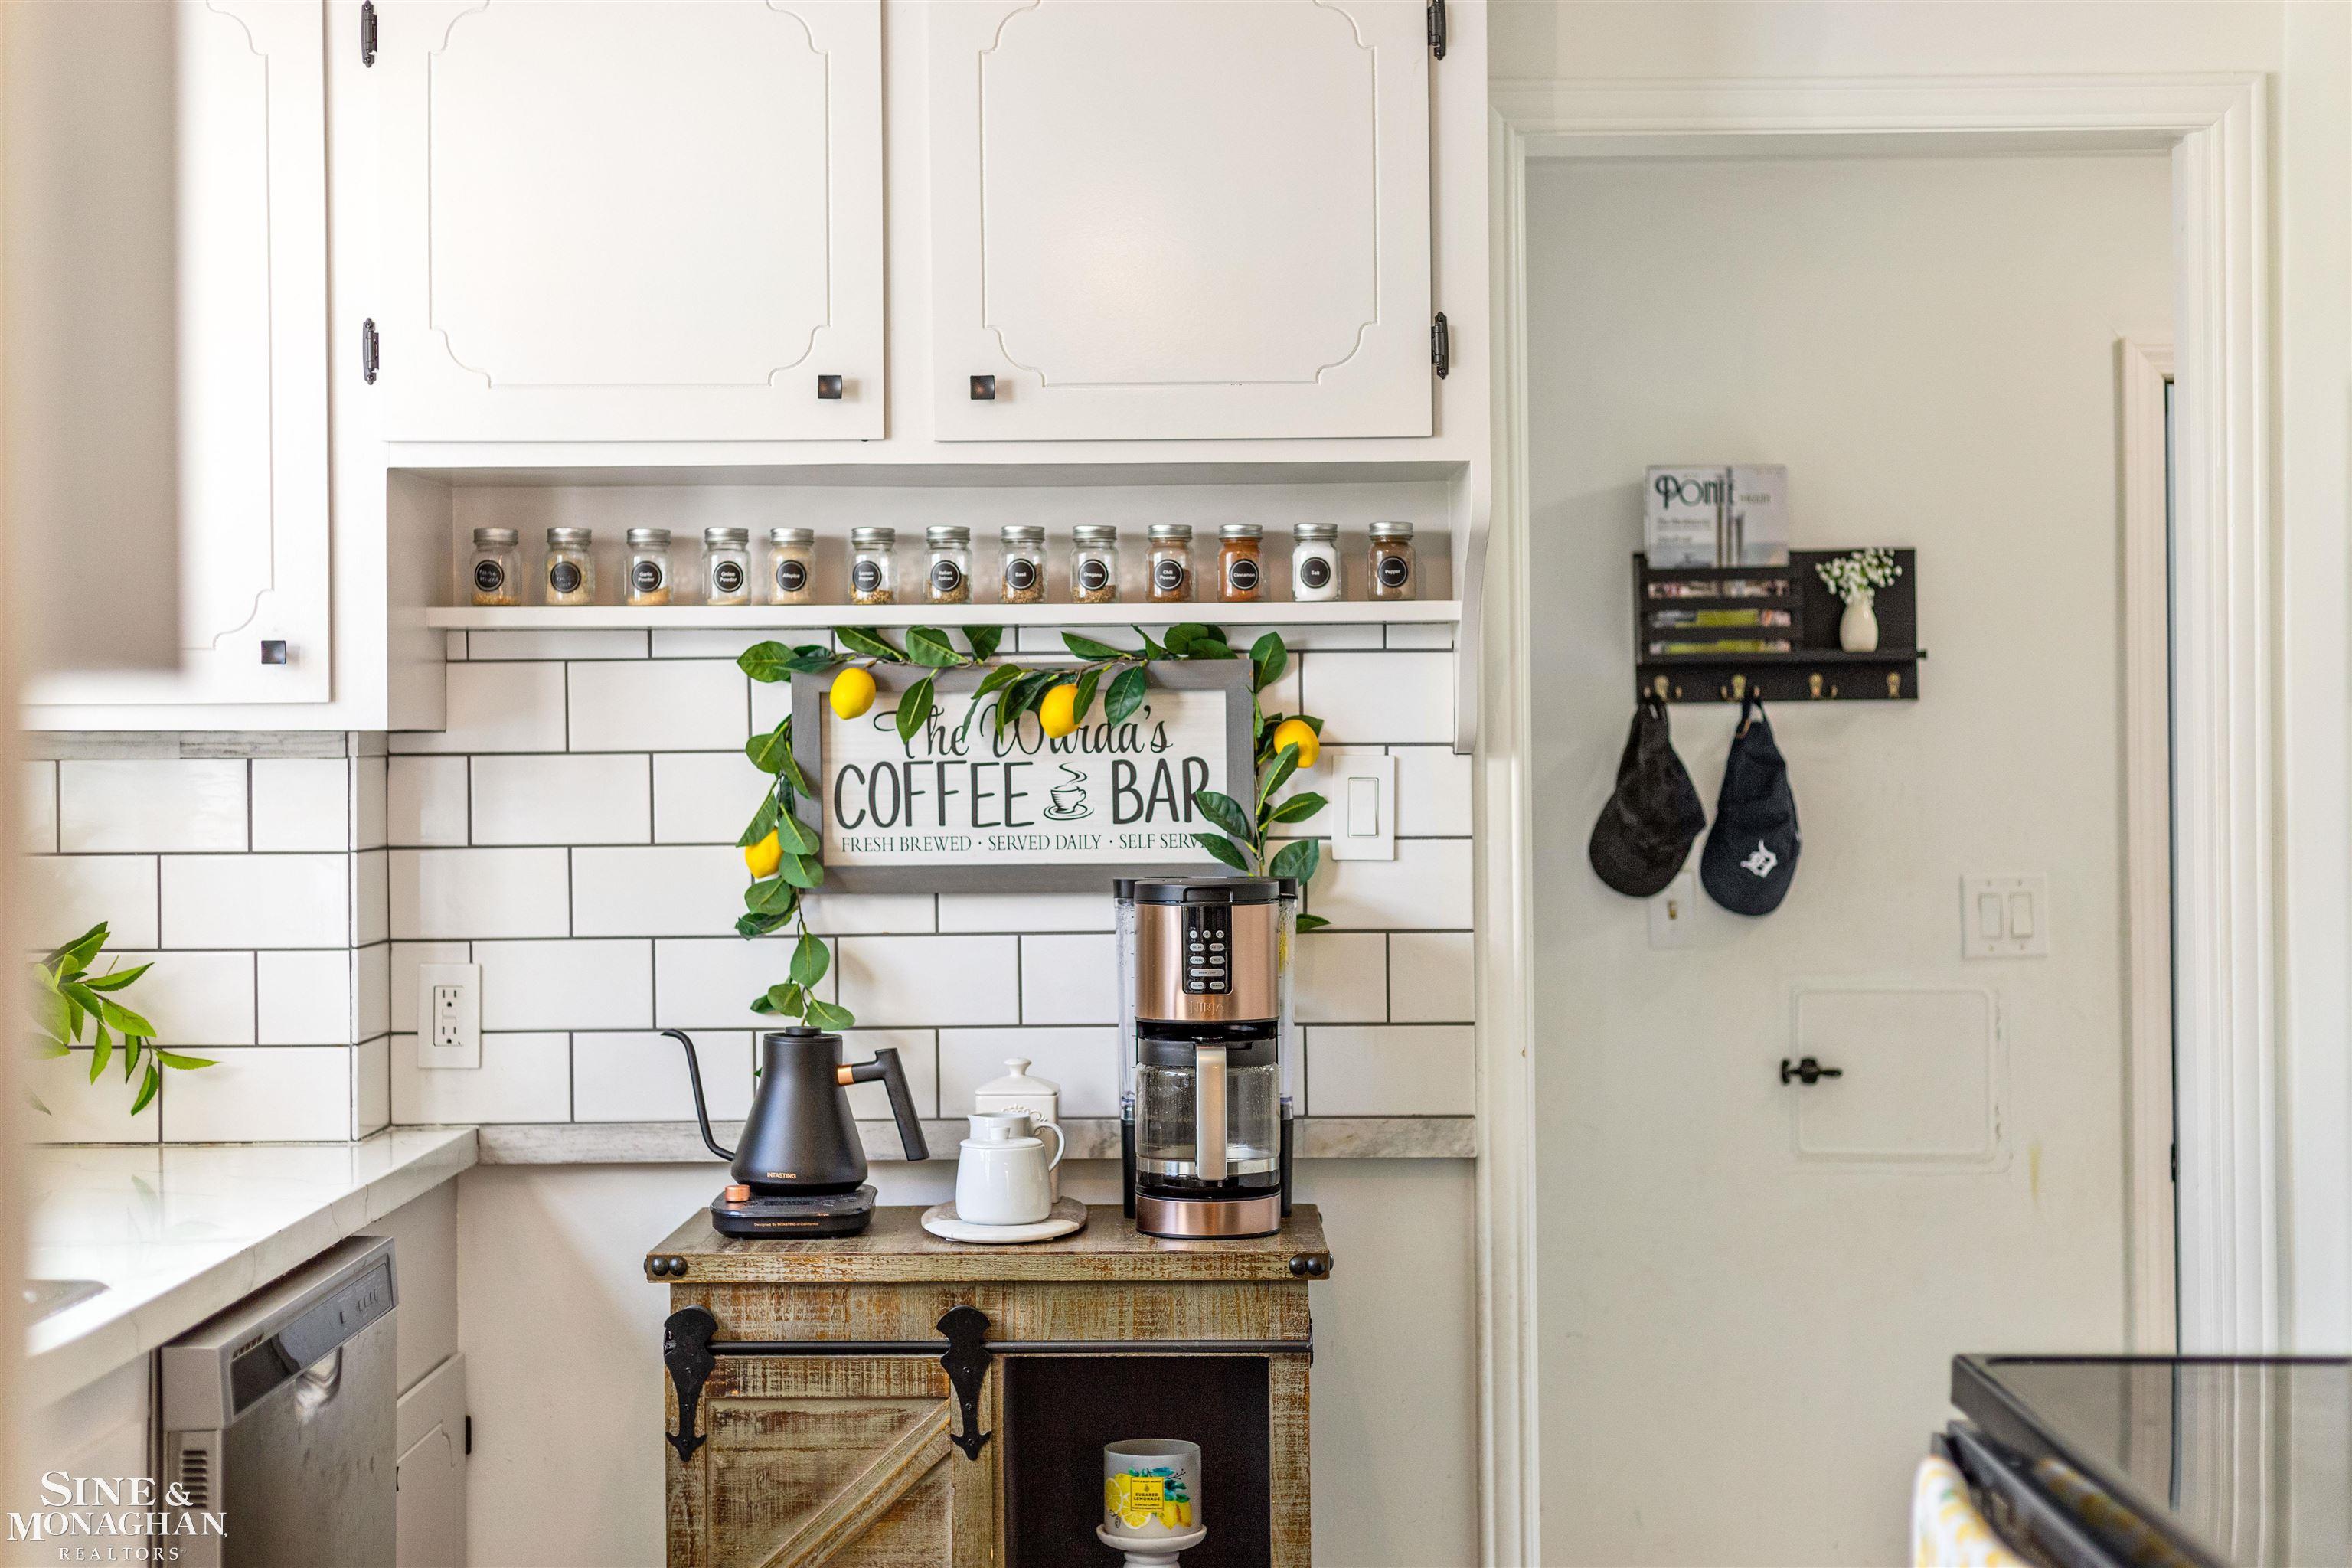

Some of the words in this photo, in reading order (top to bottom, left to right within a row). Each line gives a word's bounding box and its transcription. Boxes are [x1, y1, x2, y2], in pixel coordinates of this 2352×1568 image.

[834, 760, 1035, 830] COFFEE
[1112, 756, 1210, 825] BAR
[842, 836, 893, 852] FRESH
[900, 835, 972, 851] BREWED
[988, 835, 1050, 851] SERVED
[1056, 834, 1102, 850] DAILY
[1119, 833, 1155, 849] SELF
[1190, 1001, 1224, 1015] NINJA
